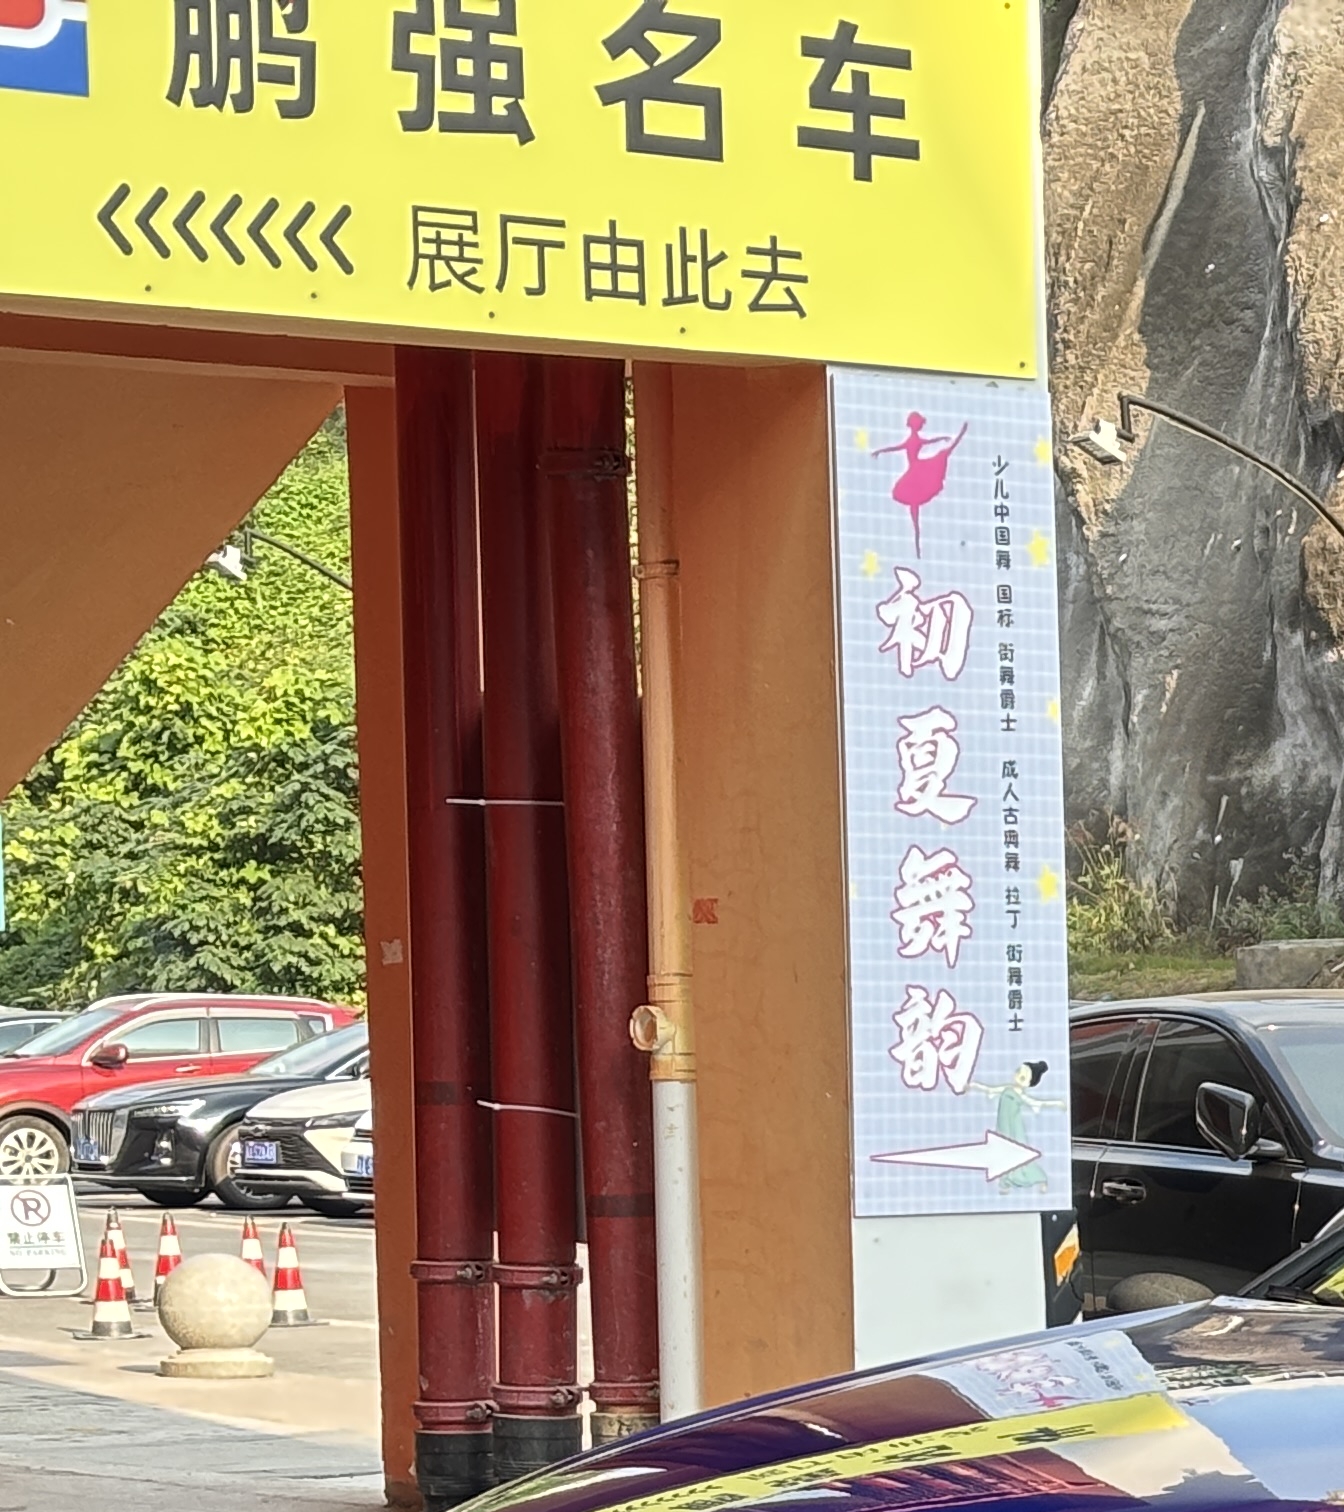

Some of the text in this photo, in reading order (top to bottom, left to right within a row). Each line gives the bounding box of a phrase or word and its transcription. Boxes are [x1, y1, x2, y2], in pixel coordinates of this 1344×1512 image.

[165, 0, 921, 182] 鹏强名车
[405, 203, 811, 318] 展厅由此去
[876, 567, 985, 1095] 初夏舞韵
[992, 455, 1025, 1032] 少儿中国舞 国标 街舞爵士 成人古典舞 拉丁 街舞爵士
